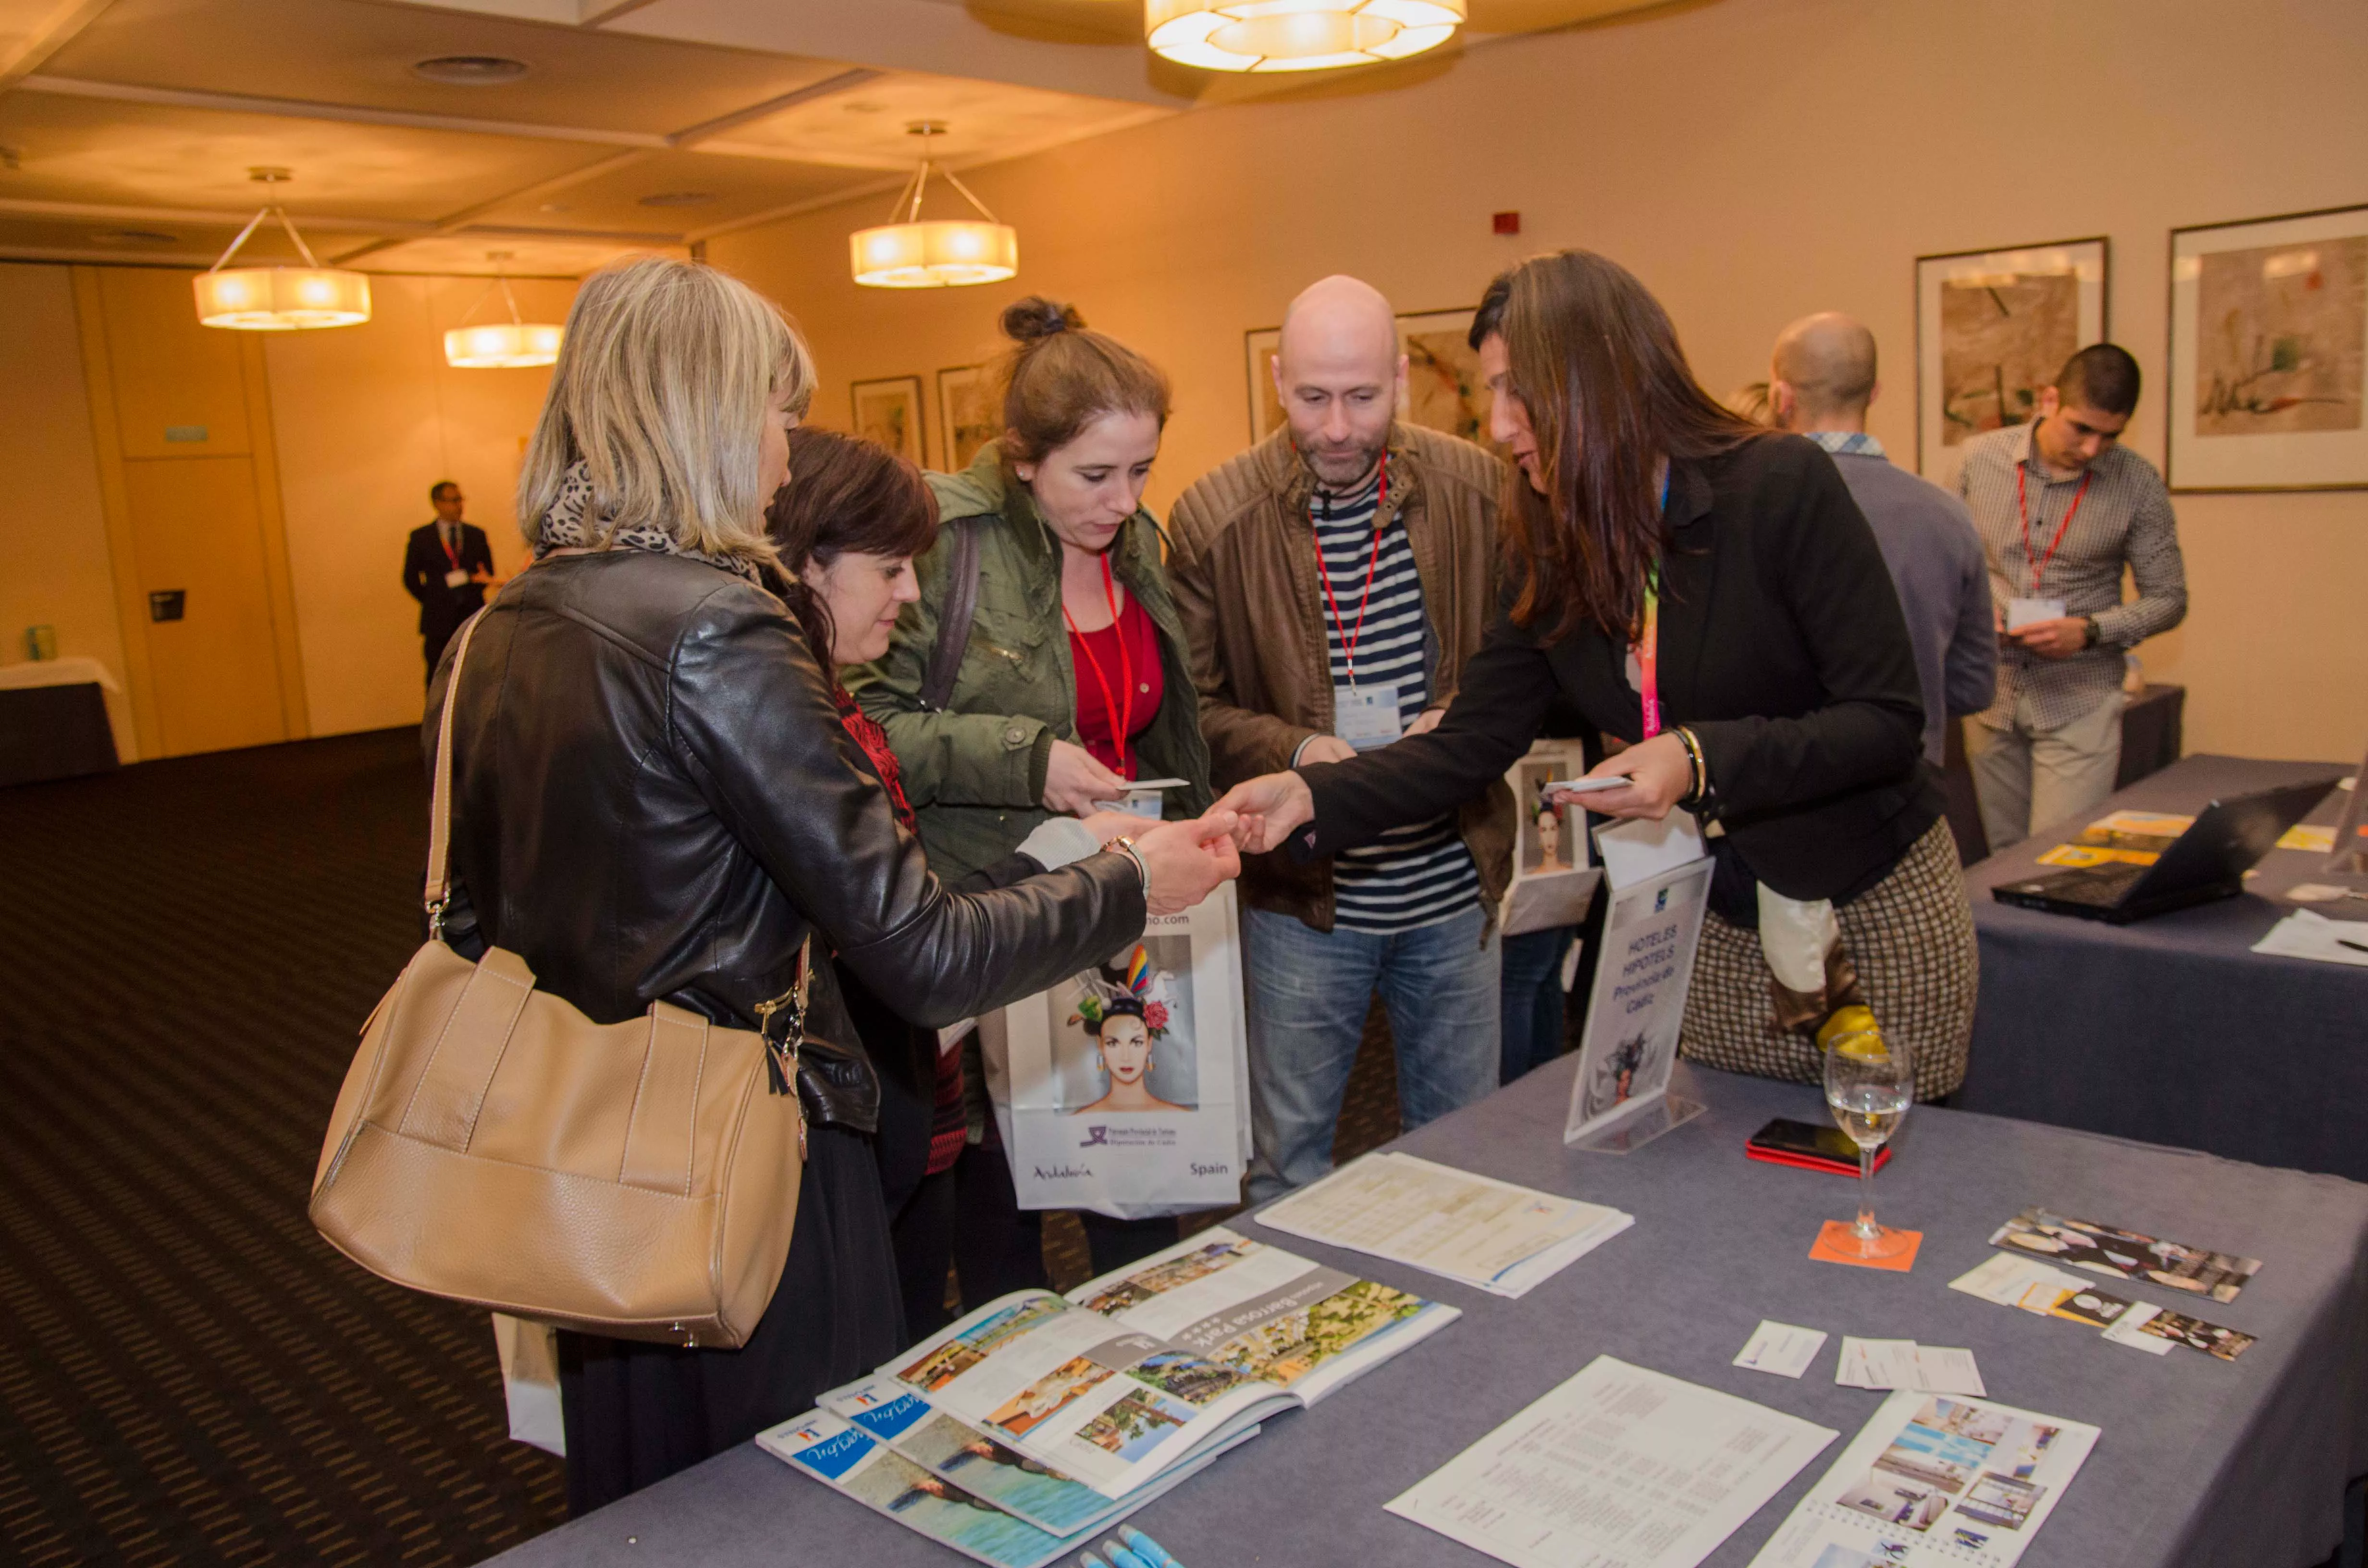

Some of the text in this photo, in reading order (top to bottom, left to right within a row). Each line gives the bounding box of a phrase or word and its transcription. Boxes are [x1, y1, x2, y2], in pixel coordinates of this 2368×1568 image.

[1190, 1163, 1229, 1176] Spain
[1232, 1297, 1298, 1326] Barrosa
[1192, 1323, 1237, 1348] Park
